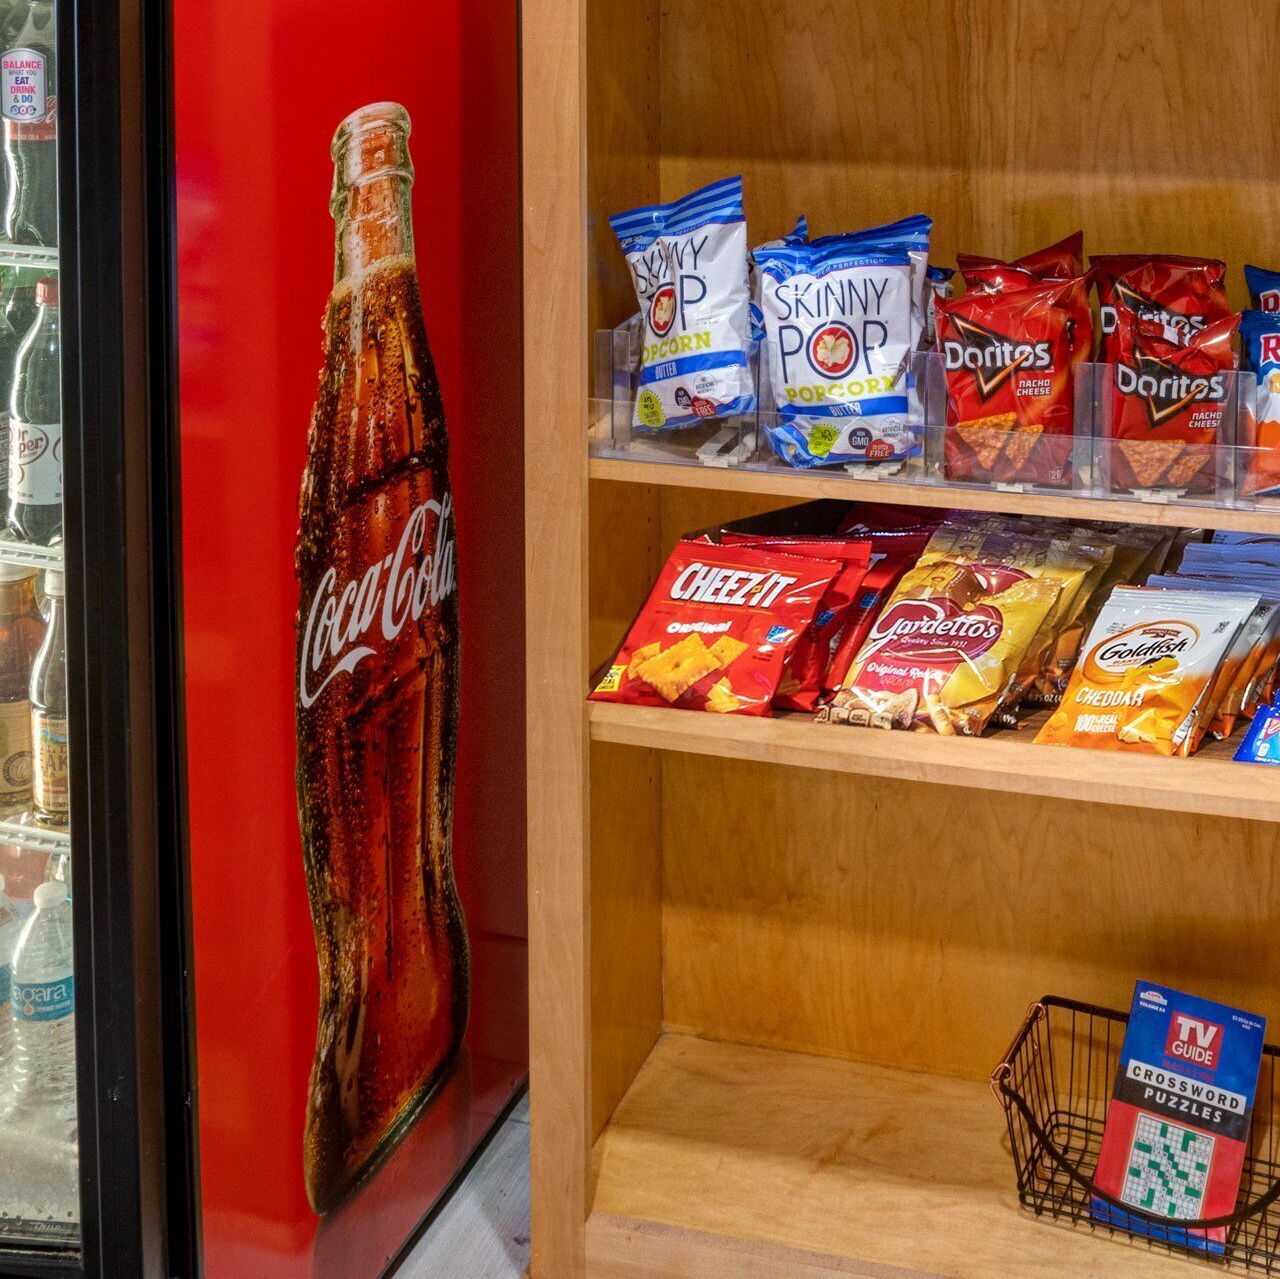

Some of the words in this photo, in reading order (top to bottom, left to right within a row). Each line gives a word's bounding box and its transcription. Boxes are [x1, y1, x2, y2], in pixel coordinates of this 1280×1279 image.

[3, 60, 42, 69] BALANCE
[10, 85, 35, 94] DRINK
[13, 95, 19, 103] &
[21, 95, 33, 103] DO
[775, 278, 888, 320] SKINNY
[641, 331, 711, 365] OPCORN
[778, 320, 888, 383] POP
[944, 341, 1051, 369] Doritos
[655, 362, 678, 380] BUTTER
[784, 374, 898, 403] POPCORN
[1019, 379, 1051, 387] NACHO
[1118, 363, 1224, 400] Doritos
[1016, 387, 1051, 396] CHEESE
[695, 404, 715, 416] FREE
[829, 402, 862, 416] BUTTER
[1192, 412, 1222, 420] NACHO
[852, 436, 869, 446] GMO
[870, 449, 890, 457] FREE
[300, 491, 457, 709] Coca-Cola
[856, 599, 999, 664] Gardetto's
[900, 636, 929, 645] Quality
[930, 638, 949, 646] Since
[1099, 637, 1189, 661] Goldfish
[867, 662, 907, 677] Original
[1075, 687, 1145, 707] CHEDDAR
[1100, 714, 1118, 724] REAL
[1177, 1016, 1217, 1049] TV
[1172, 1041, 1214, 1065] GUIDE
[1132, 1065, 1239, 1110] CROSSWORD
[1144, 1087, 1223, 1123] PUZZLES
